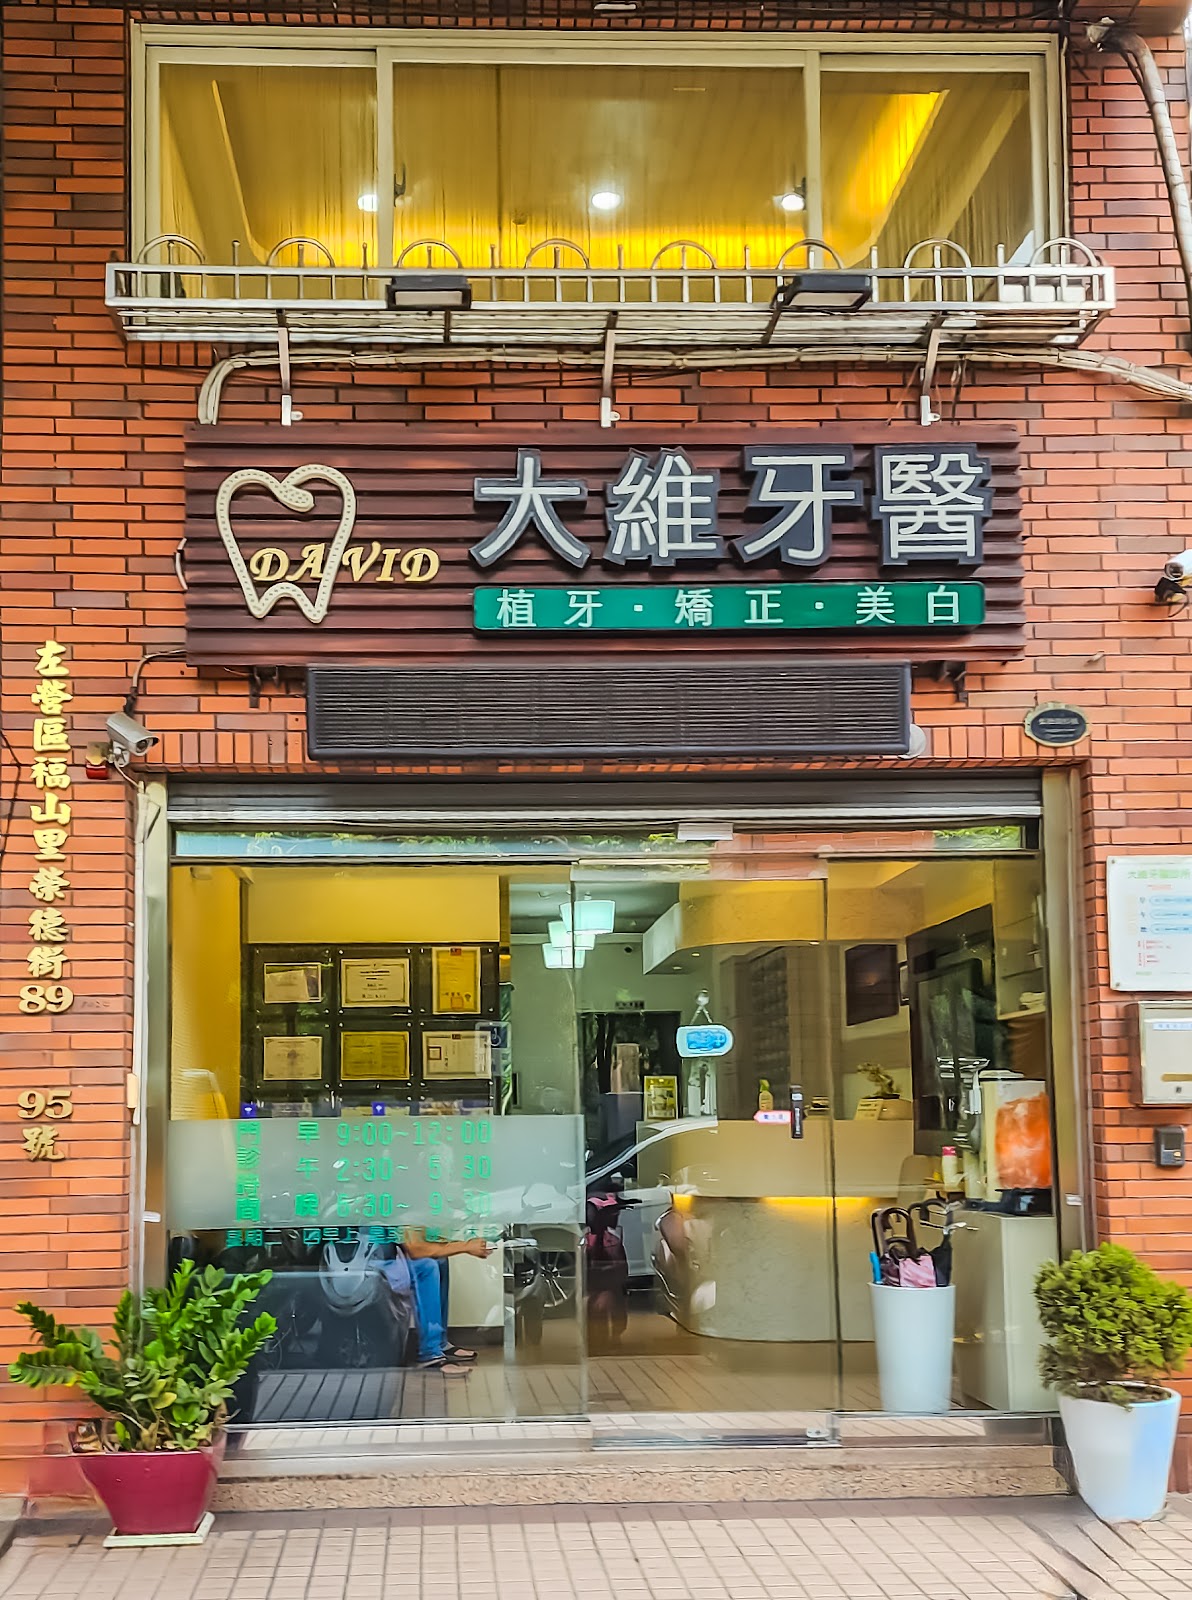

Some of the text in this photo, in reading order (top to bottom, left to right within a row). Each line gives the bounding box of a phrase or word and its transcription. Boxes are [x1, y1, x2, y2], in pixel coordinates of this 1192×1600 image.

[475, 450, 988, 563] 大維牙醫
[250, 541, 440, 583] DAVID
[297, 1121, 320, 1145] 早
[236, 1121, 261, 1221] 門診時間
[296, 1157, 319, 1179] 午
